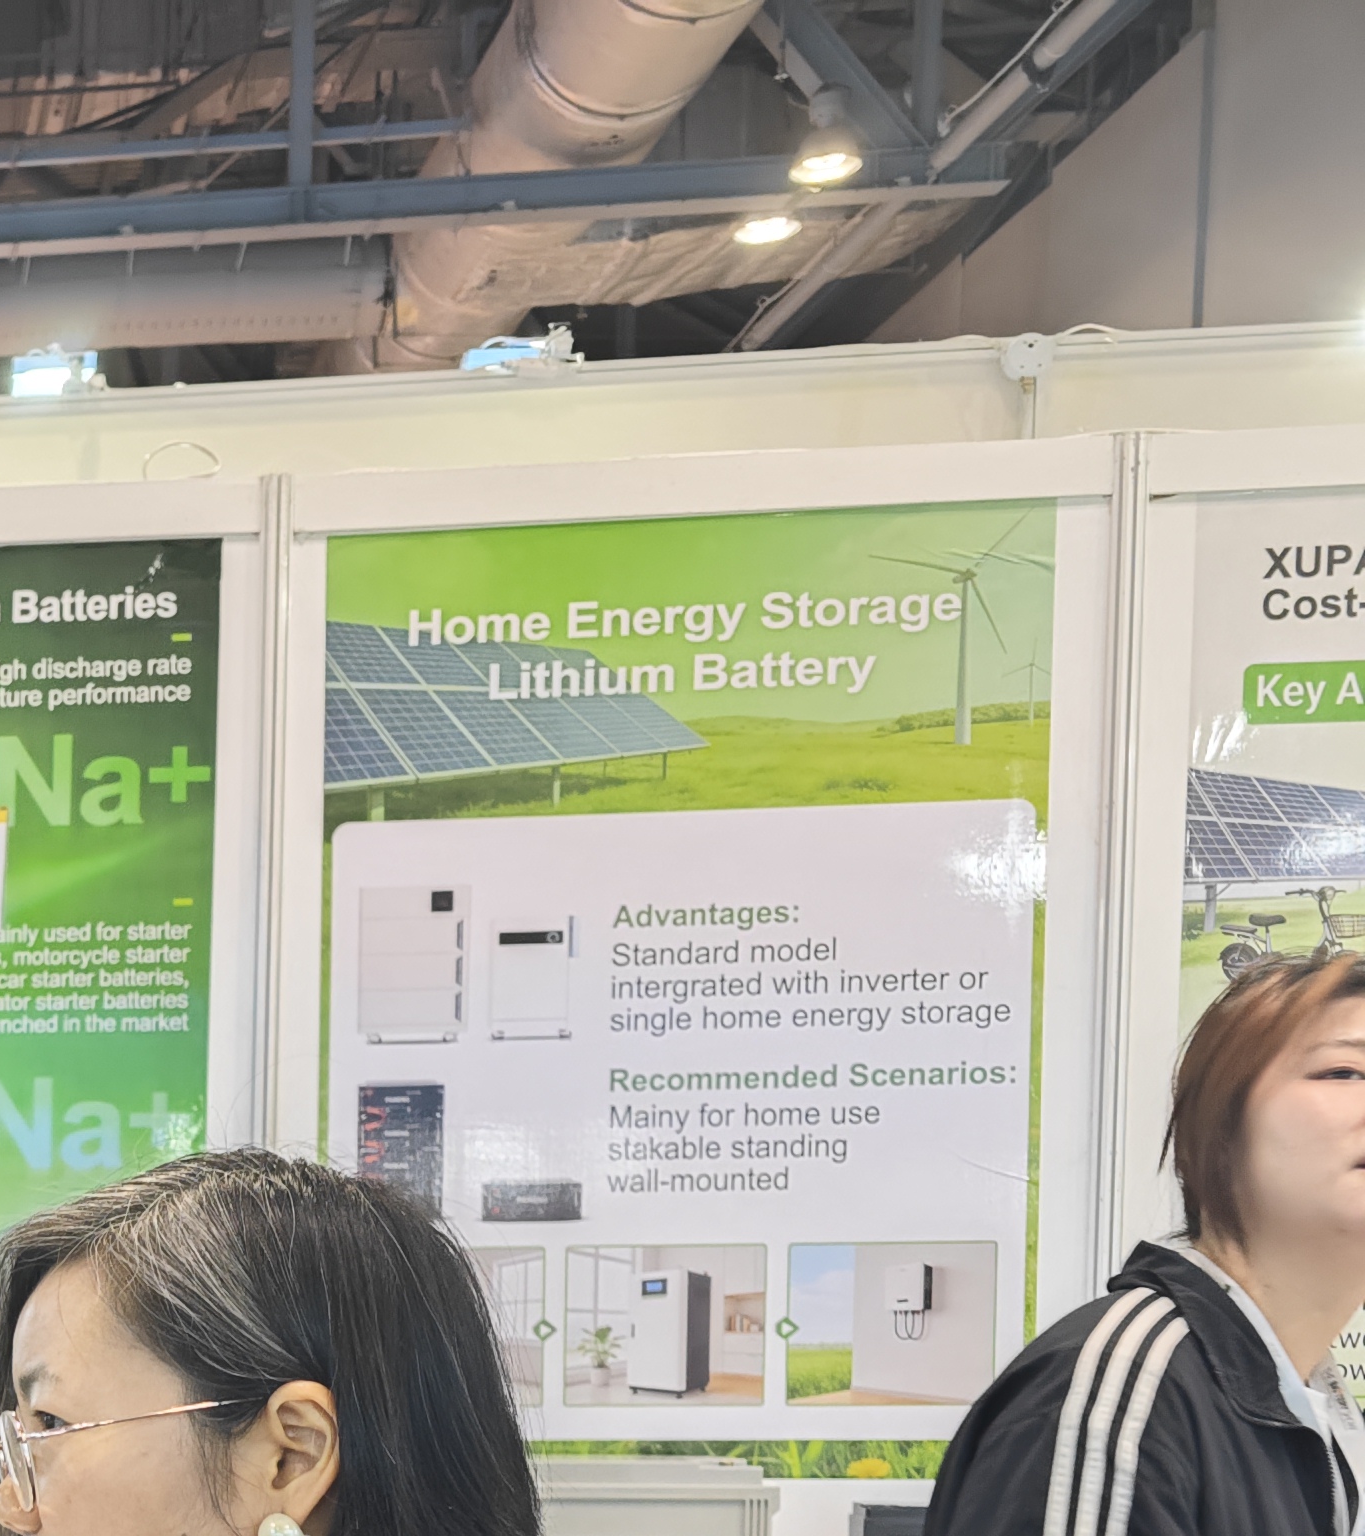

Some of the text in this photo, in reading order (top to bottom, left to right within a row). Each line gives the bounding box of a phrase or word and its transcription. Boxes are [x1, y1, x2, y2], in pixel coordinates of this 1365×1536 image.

[13, 588, 178, 625] Batteries
[408, 586, 963, 647] Home Energy Storage
[33, 657, 141, 681] discharge
[147, 656, 192, 676] rate
[489, 651, 876, 701] Lithium Battery
[48, 682, 191, 709] performance
[1257, 673, 1326, 715] Key
[613, 902, 800, 929] Advantages:
[43, 923, 89, 942] used
[93, 922, 121, 941] for
[124, 920, 191, 941] starter
[13, 945, 119, 967] motorcycle
[125, 945, 191, 964] starter
[612, 938, 838, 968] Standard model
[29, 969, 94, 988] starter
[99, 967, 190, 989] batteries,
[610, 969, 989, 1003] intergrated with inverter or
[36, 992, 98, 1011] starter
[103, 991, 188, 1011] batteries
[62, 1015, 81, 1033] in
[86, 1015, 116, 1033] the
[121, 1013, 189, 1032] market
[610, 1000, 1011, 1037] single home energy storage
[610, 1062, 1018, 1093] Recommended Scenarios:
[609, 1102, 880, 1133] Mainy for home use
[608, 1134, 848, 1163] stakable standing
[608, 1168, 790, 1193] wall-mounted
